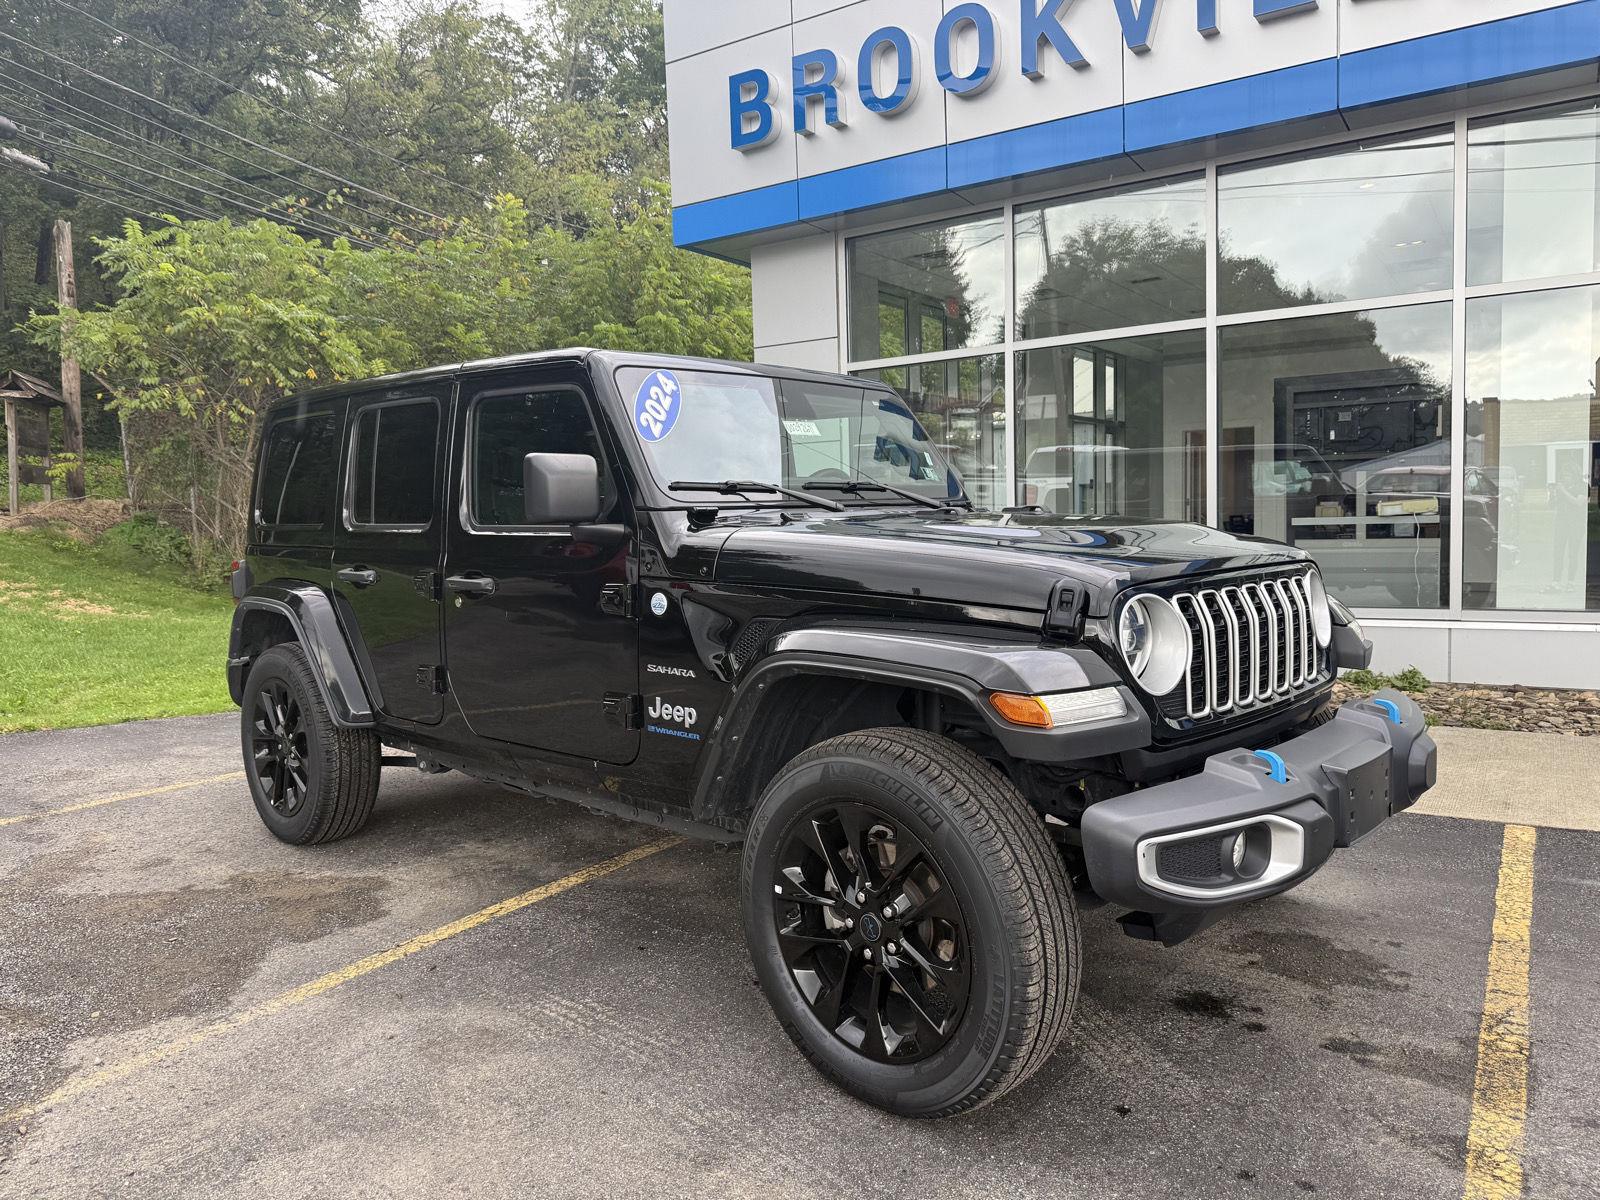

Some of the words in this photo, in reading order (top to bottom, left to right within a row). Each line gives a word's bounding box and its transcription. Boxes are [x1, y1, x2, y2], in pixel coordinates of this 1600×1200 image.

[639, 371, 679, 440] 2024
[646, 663, 697, 678] SAHARA
[648, 696, 698, 729] Jeep
[655, 725, 702, 741] WRANGLER
